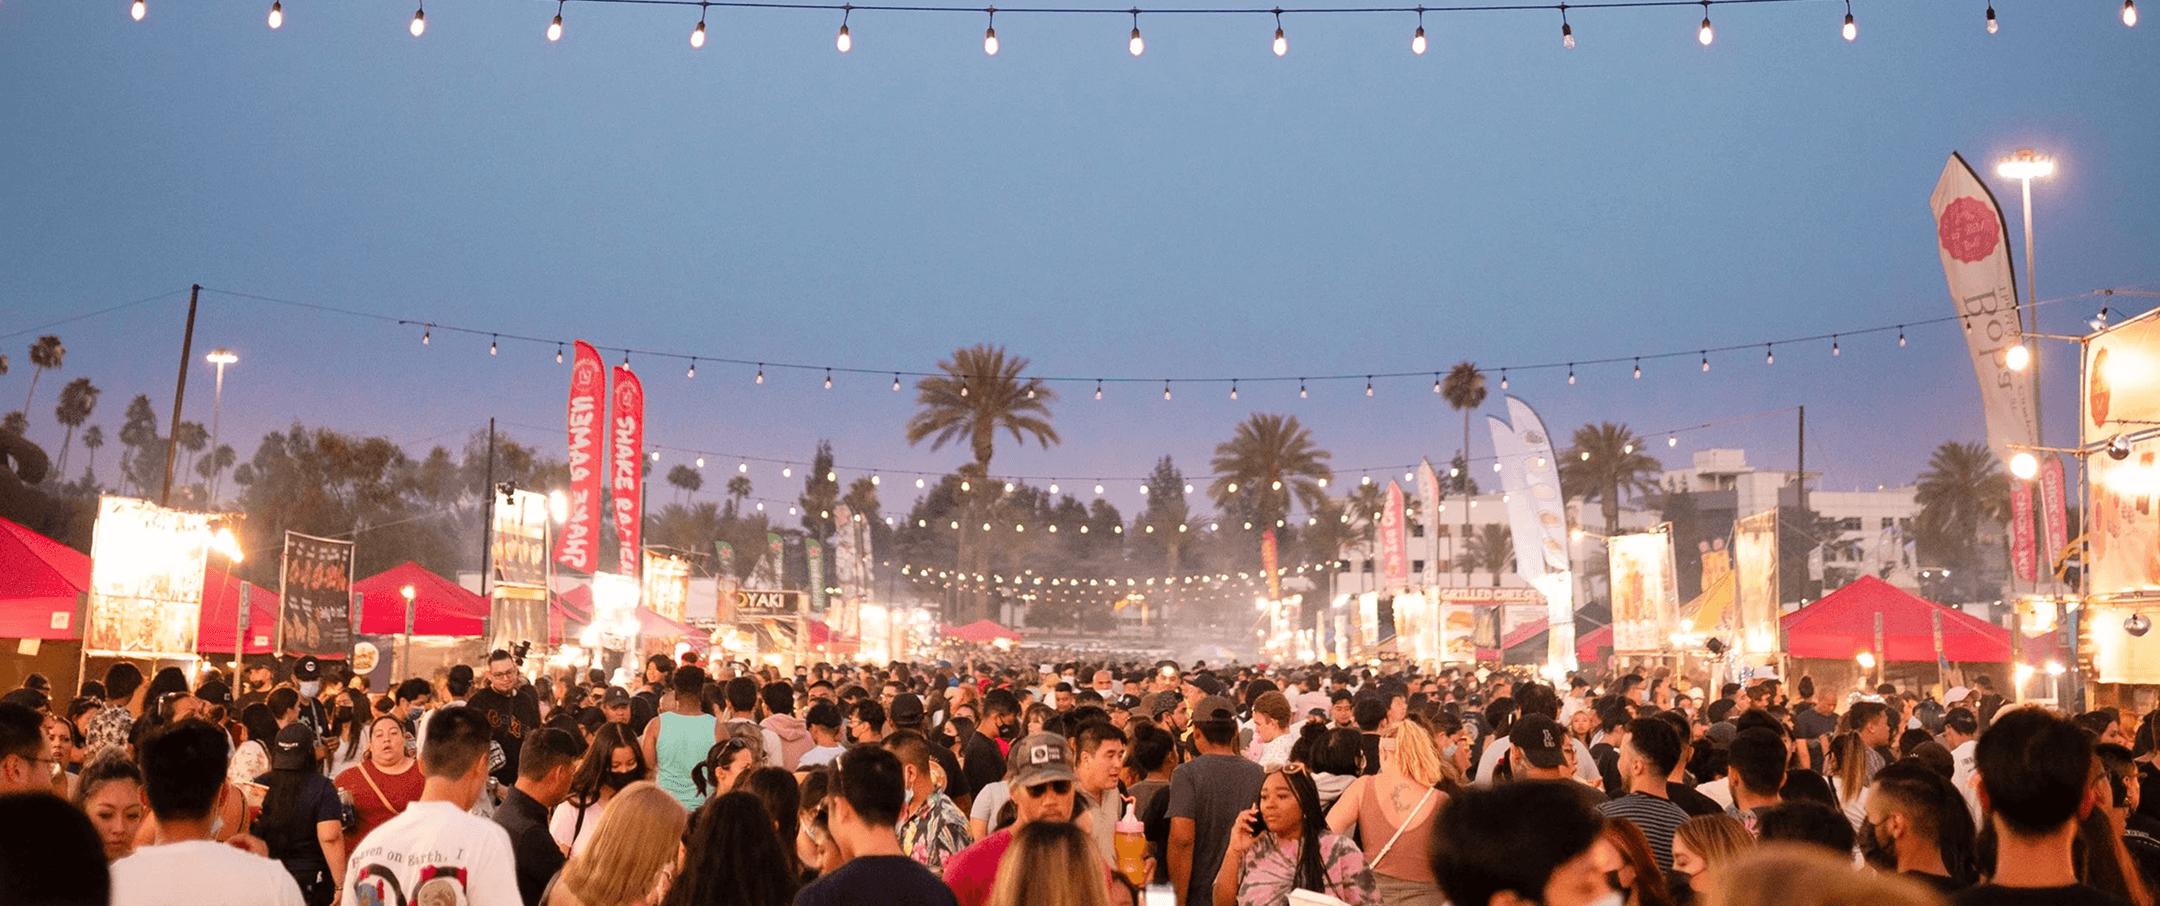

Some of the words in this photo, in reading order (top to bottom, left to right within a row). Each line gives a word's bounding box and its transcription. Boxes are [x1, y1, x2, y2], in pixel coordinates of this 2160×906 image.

[614, 415, 635, 491] SHAKE
[1384, 529, 1398, 553] Ice
[1441, 588, 1492, 601] GRILLED
[386, 850, 403, 863] on
[456, 848, 464, 860] I
